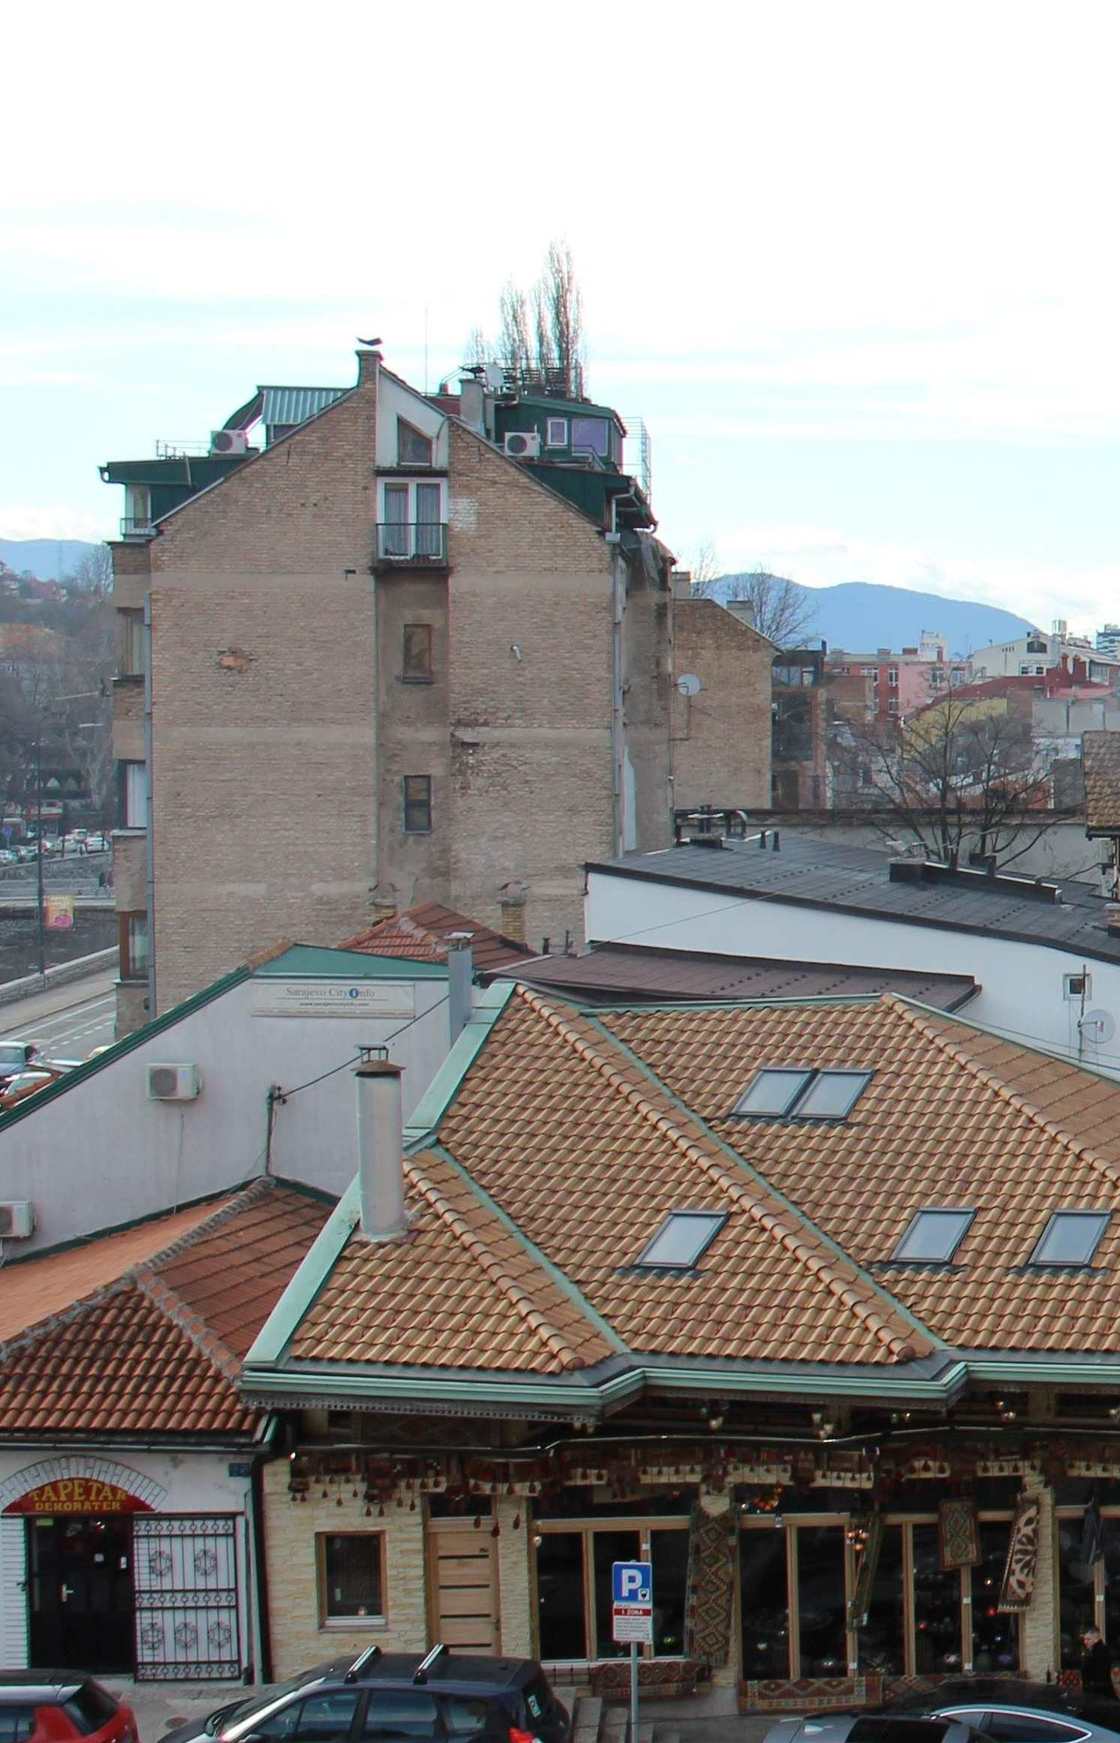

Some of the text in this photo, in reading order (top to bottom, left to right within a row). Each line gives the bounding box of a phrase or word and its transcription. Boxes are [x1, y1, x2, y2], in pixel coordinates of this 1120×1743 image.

[329, 987, 348, 999] City
[29, 1480, 128, 1501] TAPETAR
[34, 1501, 121, 1512] DEKORATER
[622, 1569, 642, 1597] P
